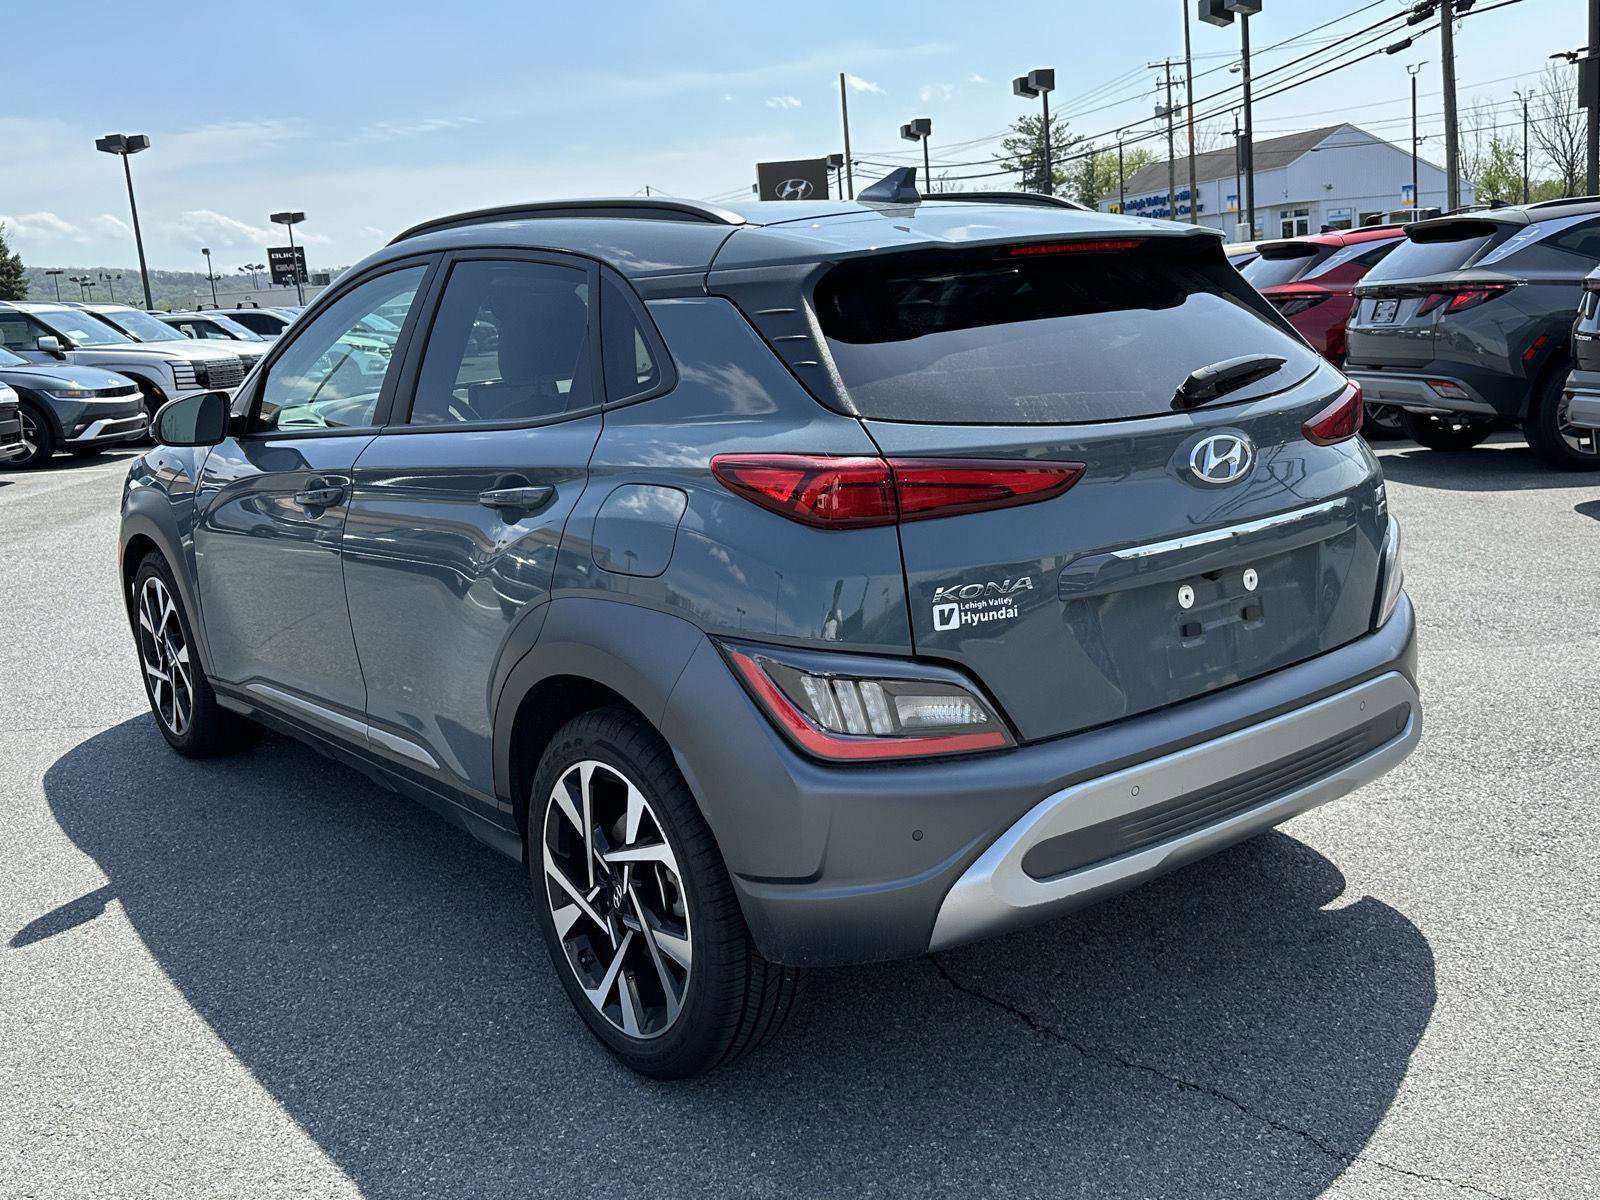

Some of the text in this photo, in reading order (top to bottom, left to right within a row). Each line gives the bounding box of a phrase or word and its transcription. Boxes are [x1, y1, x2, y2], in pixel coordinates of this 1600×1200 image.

[275, 263, 303, 272] GMC
[932, 576, 1034, 603] KONA
[960, 597, 1013, 610] Lehigh Valley
[960, 605, 1019, 626] Hyundai
